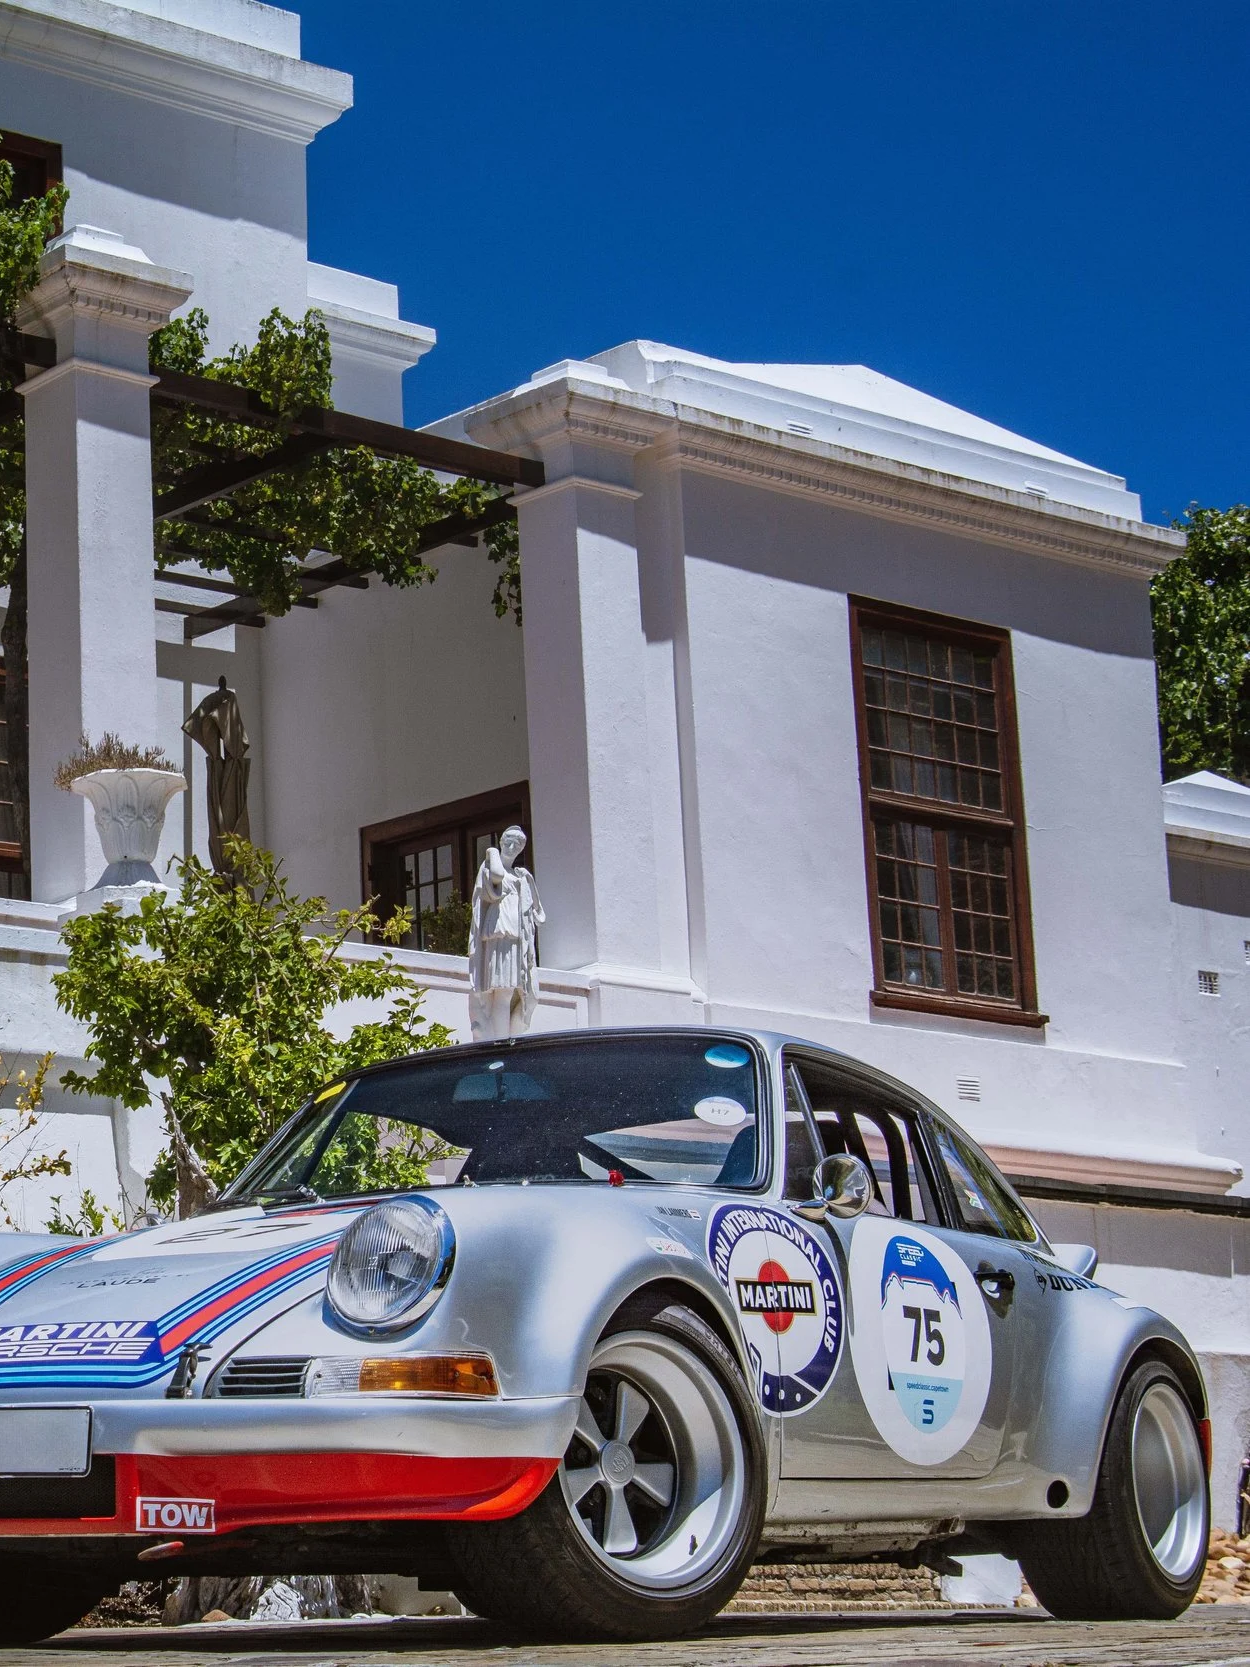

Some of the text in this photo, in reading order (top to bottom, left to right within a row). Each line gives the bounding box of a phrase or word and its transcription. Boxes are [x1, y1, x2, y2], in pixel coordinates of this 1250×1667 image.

[76, 1277, 158, 1289] LAUDE
[715, 1209, 838, 1353] TINI INTERNATIONAL CLUB
[739, 1284, 812, 1309] MARTINI
[902, 1305, 945, 1366] 75
[142, 1503, 210, 1527] TOW
